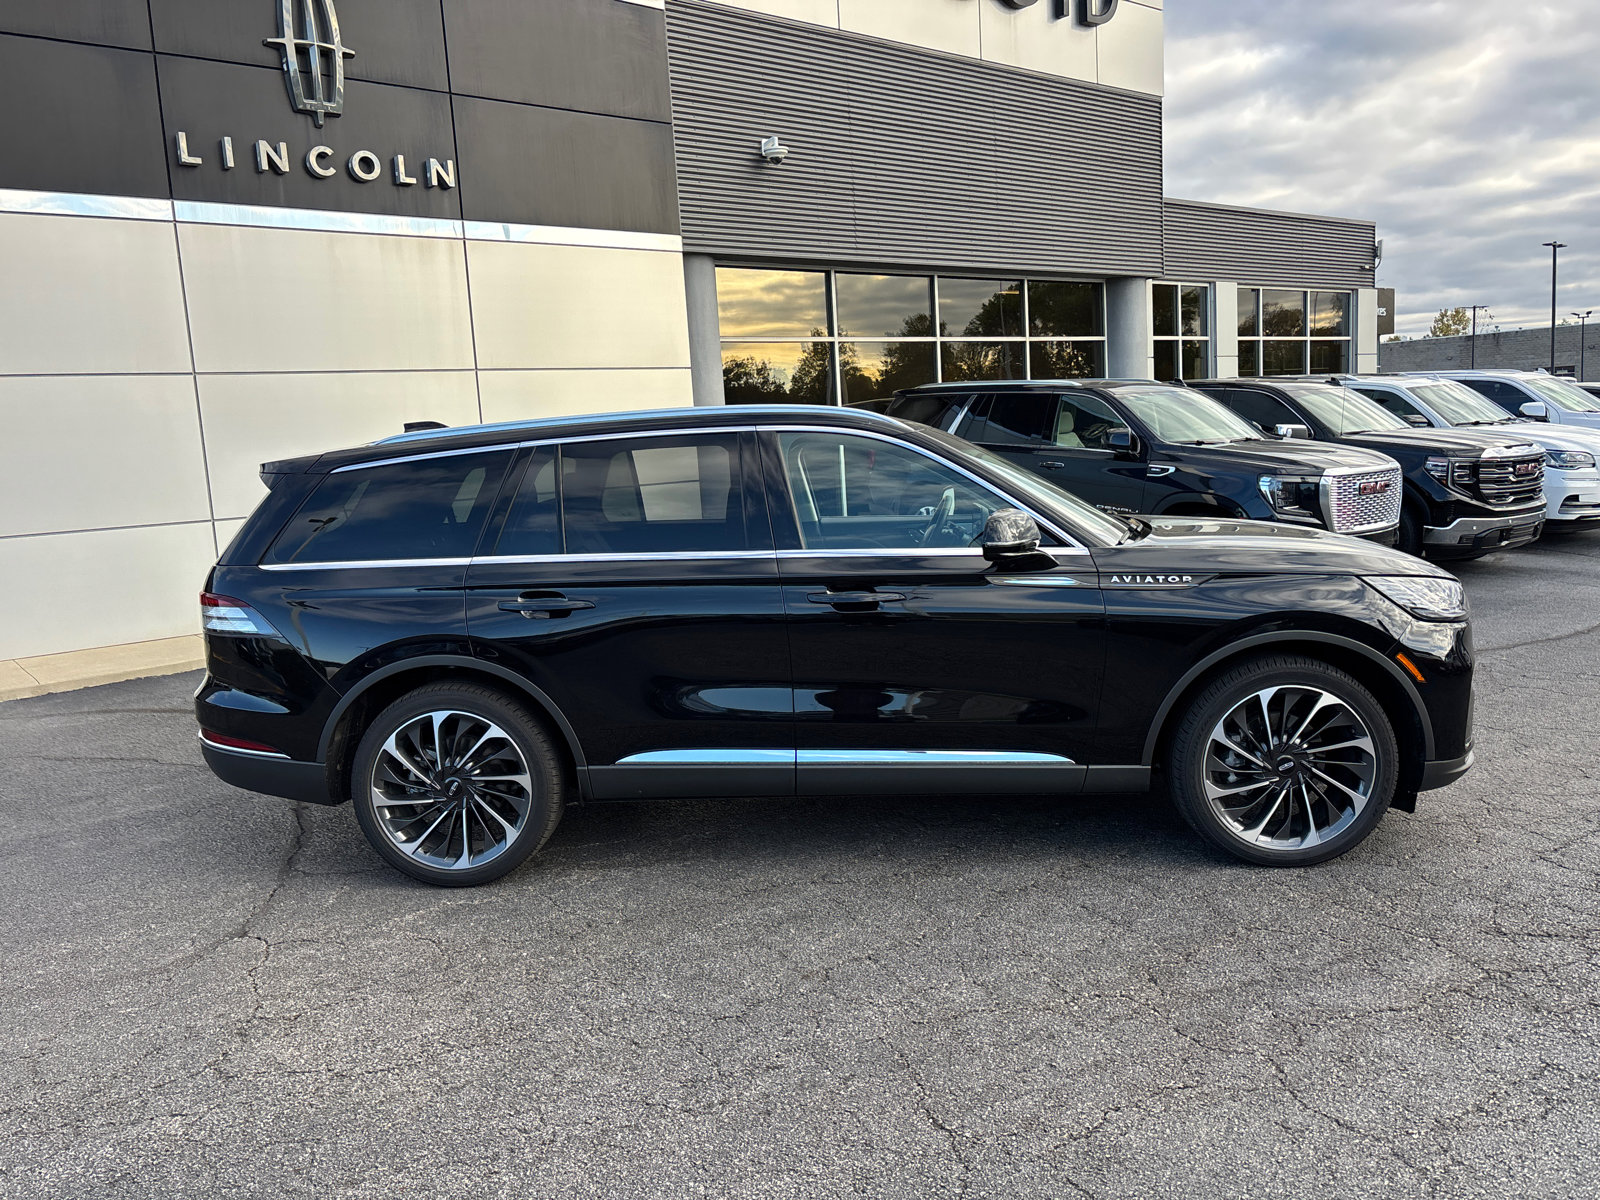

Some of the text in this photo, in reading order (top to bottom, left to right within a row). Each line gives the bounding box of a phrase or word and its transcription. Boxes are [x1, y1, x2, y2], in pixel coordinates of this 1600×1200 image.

[176, 131, 456, 189] LINCOLN
[1515, 463, 1538, 474] GMC
[1360, 482, 1390, 494] GMC
[1096, 504, 1139, 514] DENALI
[1110, 575, 1193, 584] AVIATOR
